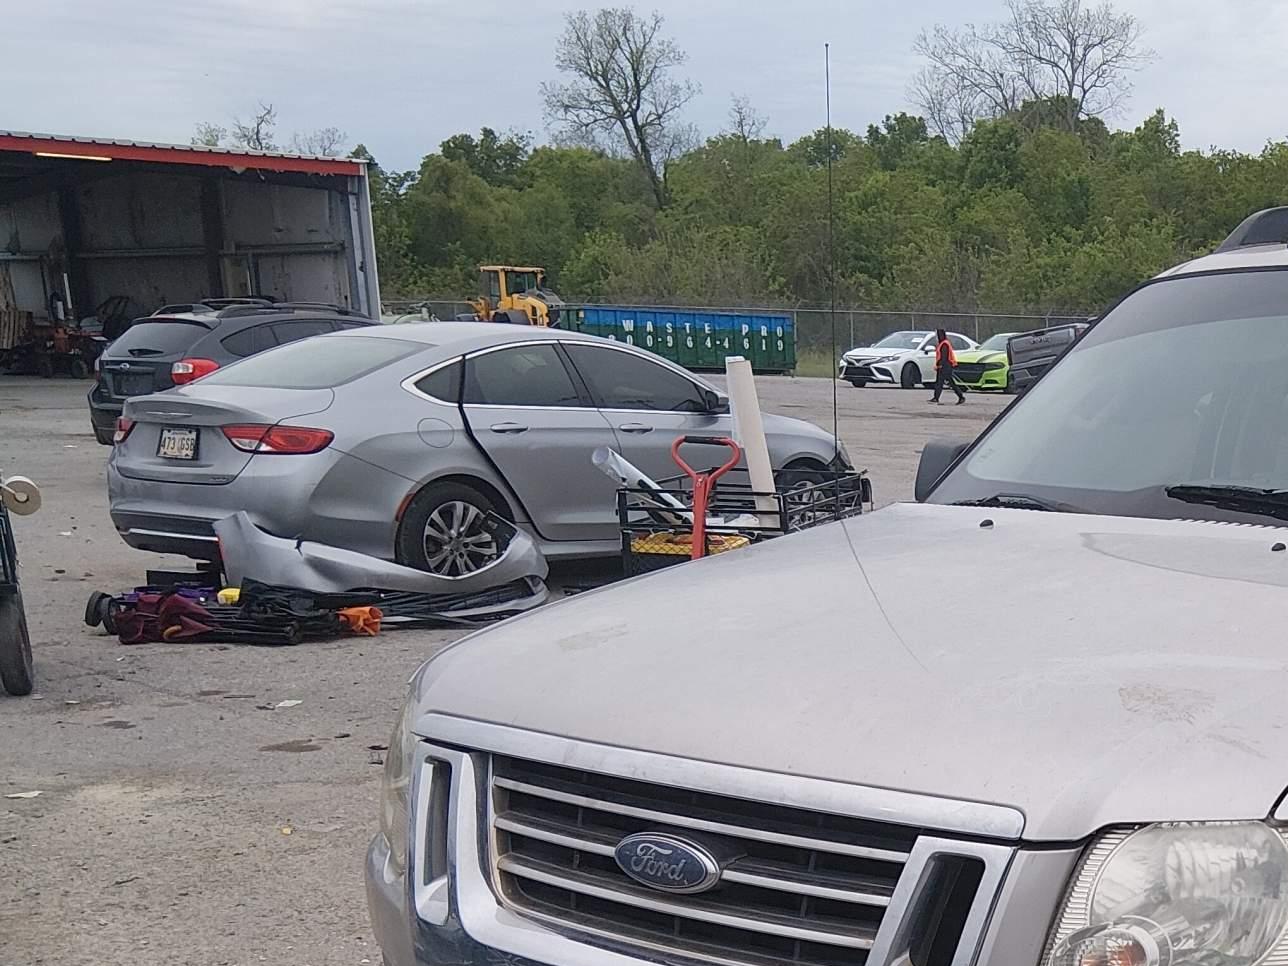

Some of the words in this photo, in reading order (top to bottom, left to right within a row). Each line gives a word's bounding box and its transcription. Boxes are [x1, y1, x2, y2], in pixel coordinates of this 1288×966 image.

[622, 319, 712, 335] WASTE
[741, 324, 784, 338] PRO
[631, 842, 687, 881] Ford
